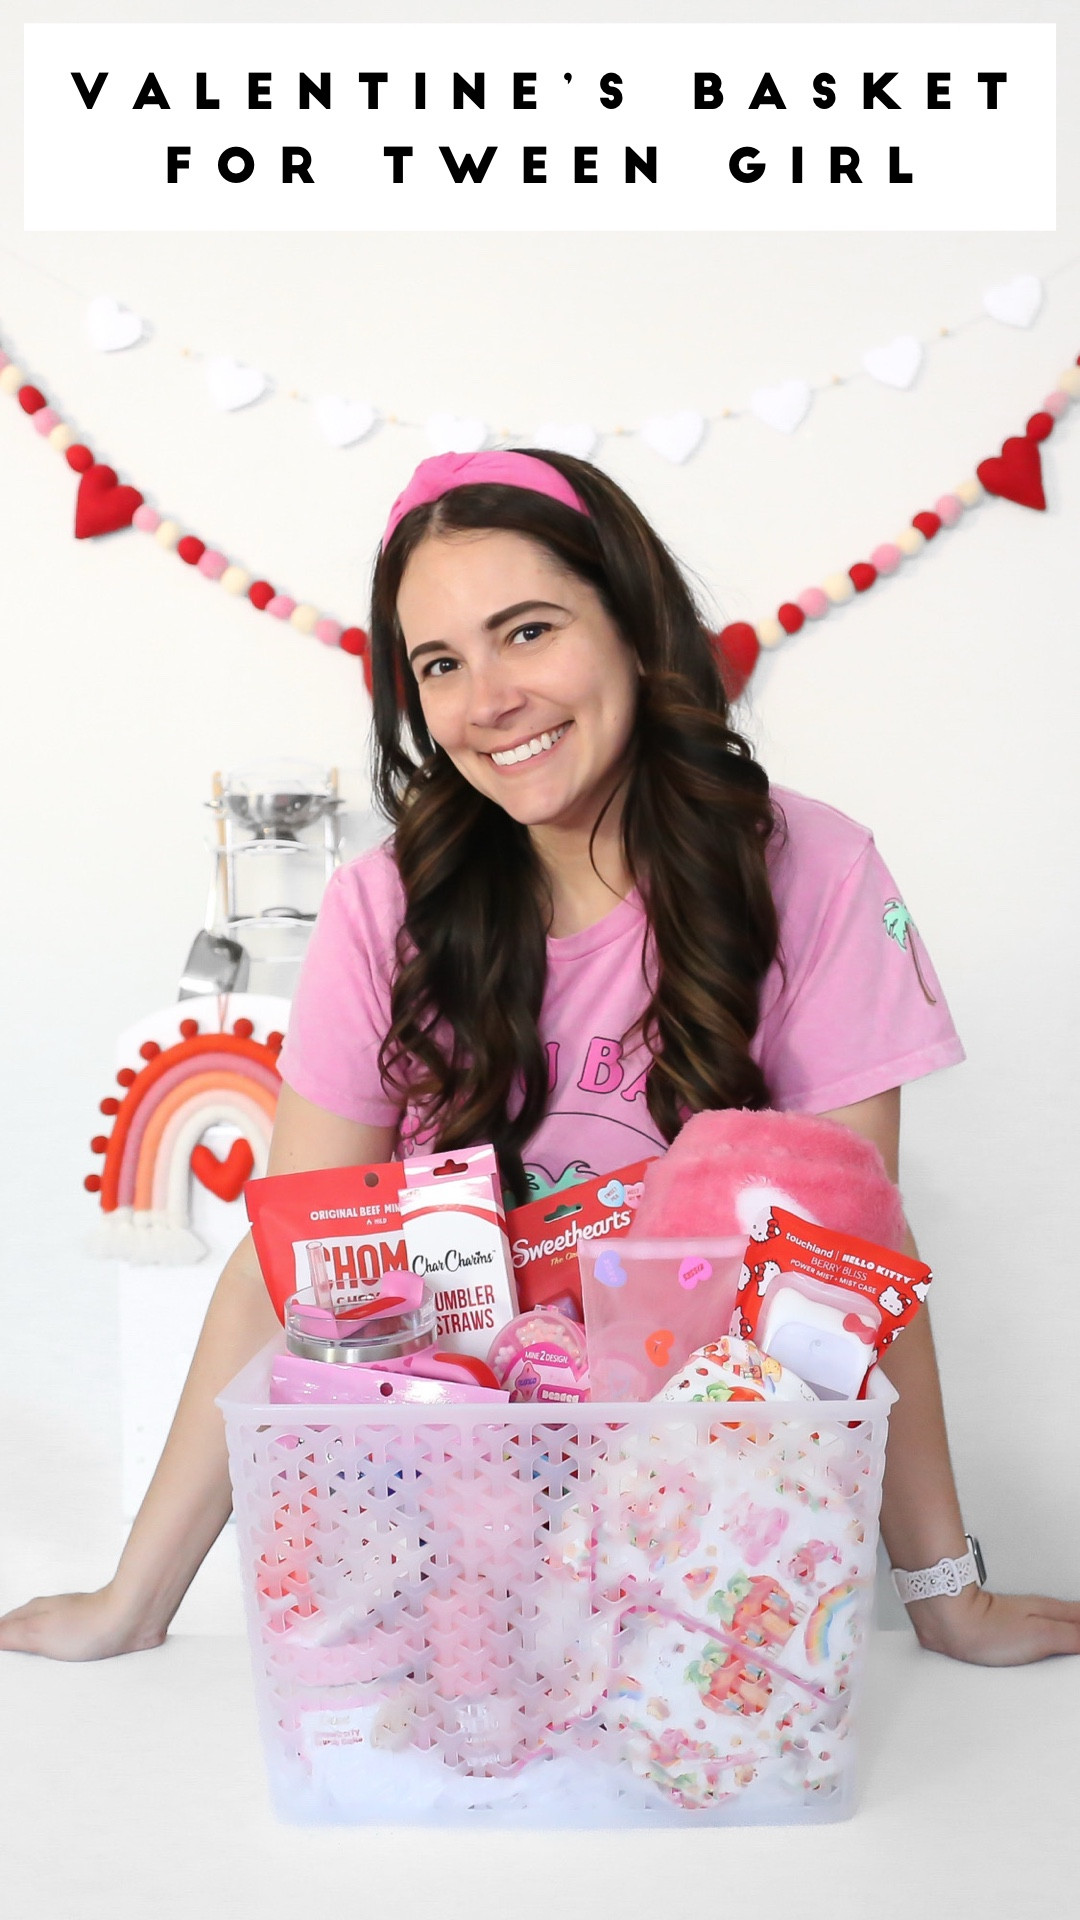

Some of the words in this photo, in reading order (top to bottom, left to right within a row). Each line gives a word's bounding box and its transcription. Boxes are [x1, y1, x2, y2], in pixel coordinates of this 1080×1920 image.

[310, 1208, 358, 1221] ORIGINAL
[359, 1205, 381, 1217] BEEF
[512, 1210, 631, 1268] Sweethearts
[412, 1255, 444, 1278] Char
[445, 1249, 493, 1273] Charms
[785, 1232, 834, 1259] touchland
[842, 1254, 875, 1270] HELLO
[876, 1265, 912, 1285] KITTY
[811, 1256, 841, 1273] BERRY
[842, 1266, 867, 1281] BLISS
[790, 1259, 815, 1274] POWER
[816, 1269, 834, 1281] MIST
[839, 1276, 857, 1287] MIST
[857, 1282, 877, 1294] CASE
[434, 1284, 495, 1312] UMBLER
[436, 1308, 494, 1336] STRAWS
